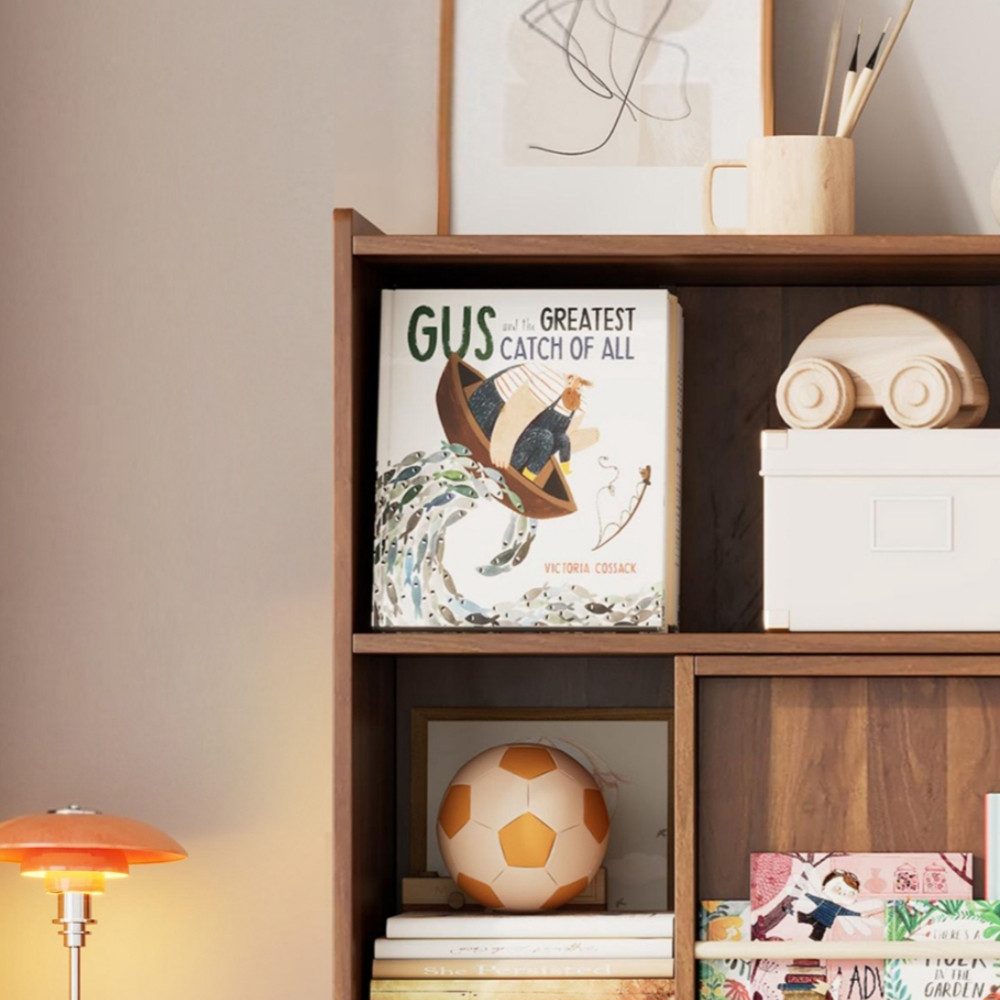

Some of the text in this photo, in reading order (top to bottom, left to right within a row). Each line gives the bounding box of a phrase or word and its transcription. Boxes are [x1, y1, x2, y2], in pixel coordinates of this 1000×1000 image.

[540, 306, 636, 331] GREATEST
[407, 304, 497, 362] GUS
[500, 336, 635, 360] CATCH OF ALL
[544, 562, 637, 574] VICTORIA COSSACK
[924, 981, 985, 998] GARDEN
